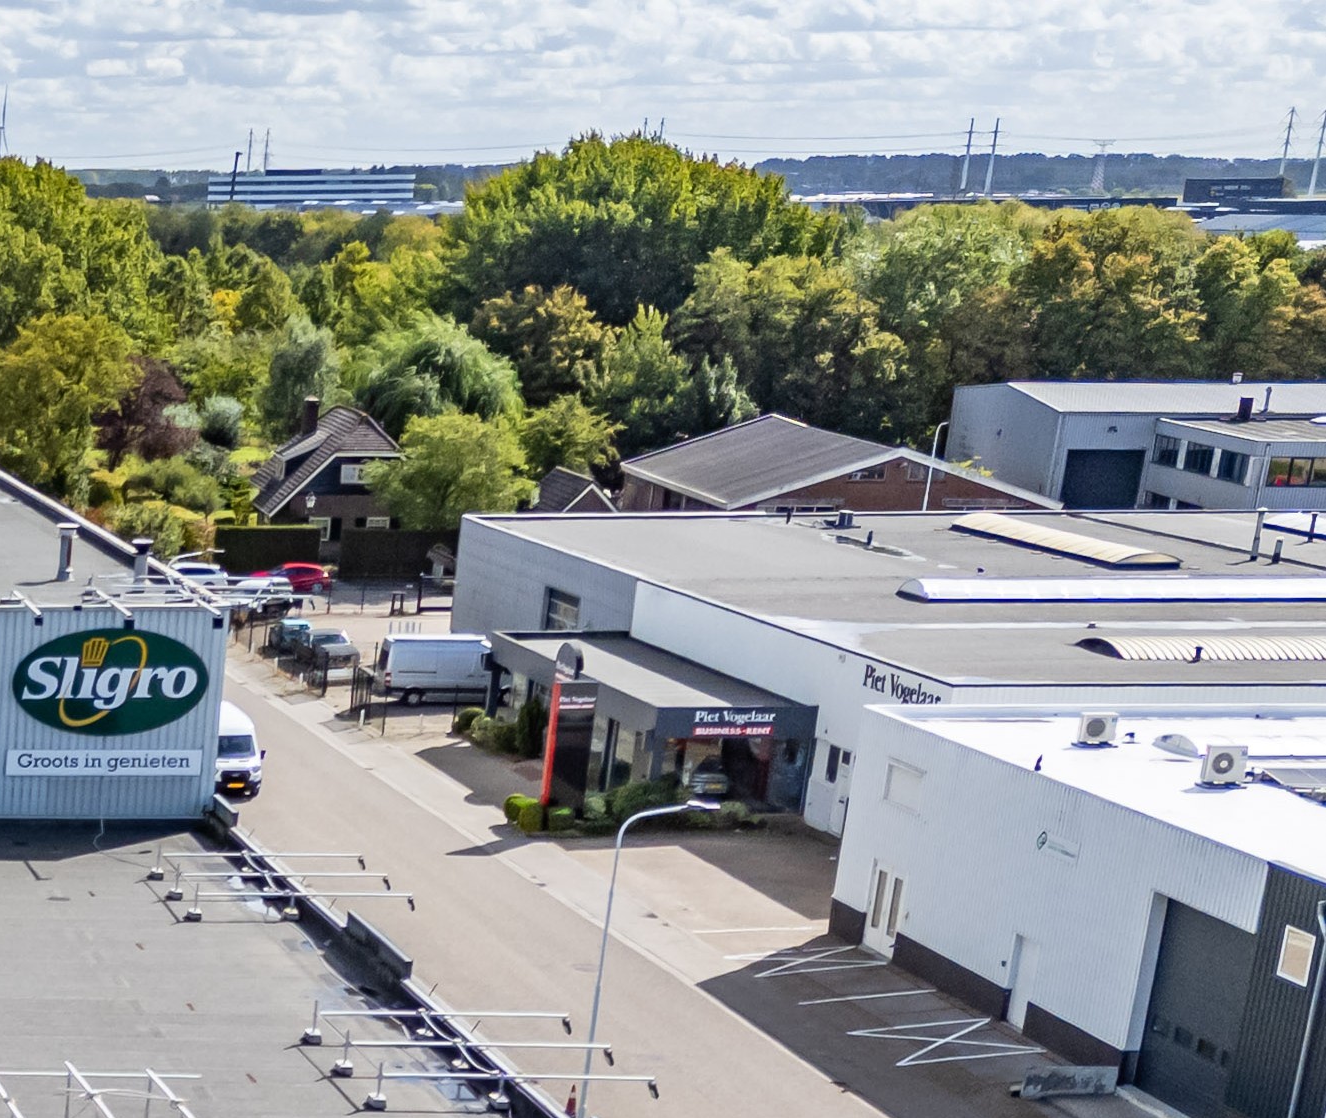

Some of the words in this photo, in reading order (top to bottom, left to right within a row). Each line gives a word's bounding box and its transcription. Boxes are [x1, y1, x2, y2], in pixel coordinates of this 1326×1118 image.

[21, 656, 198, 711] Sligro
[862, 663, 887, 694] Piet
[890, 672, 942, 705] Vogelaar
[694, 710, 720, 723] Piet
[723, 710, 777, 726] Vogelaar
[17, 753, 79, 769] Groots
[84, 753, 101, 769] in
[107, 753, 191, 773] genieten
